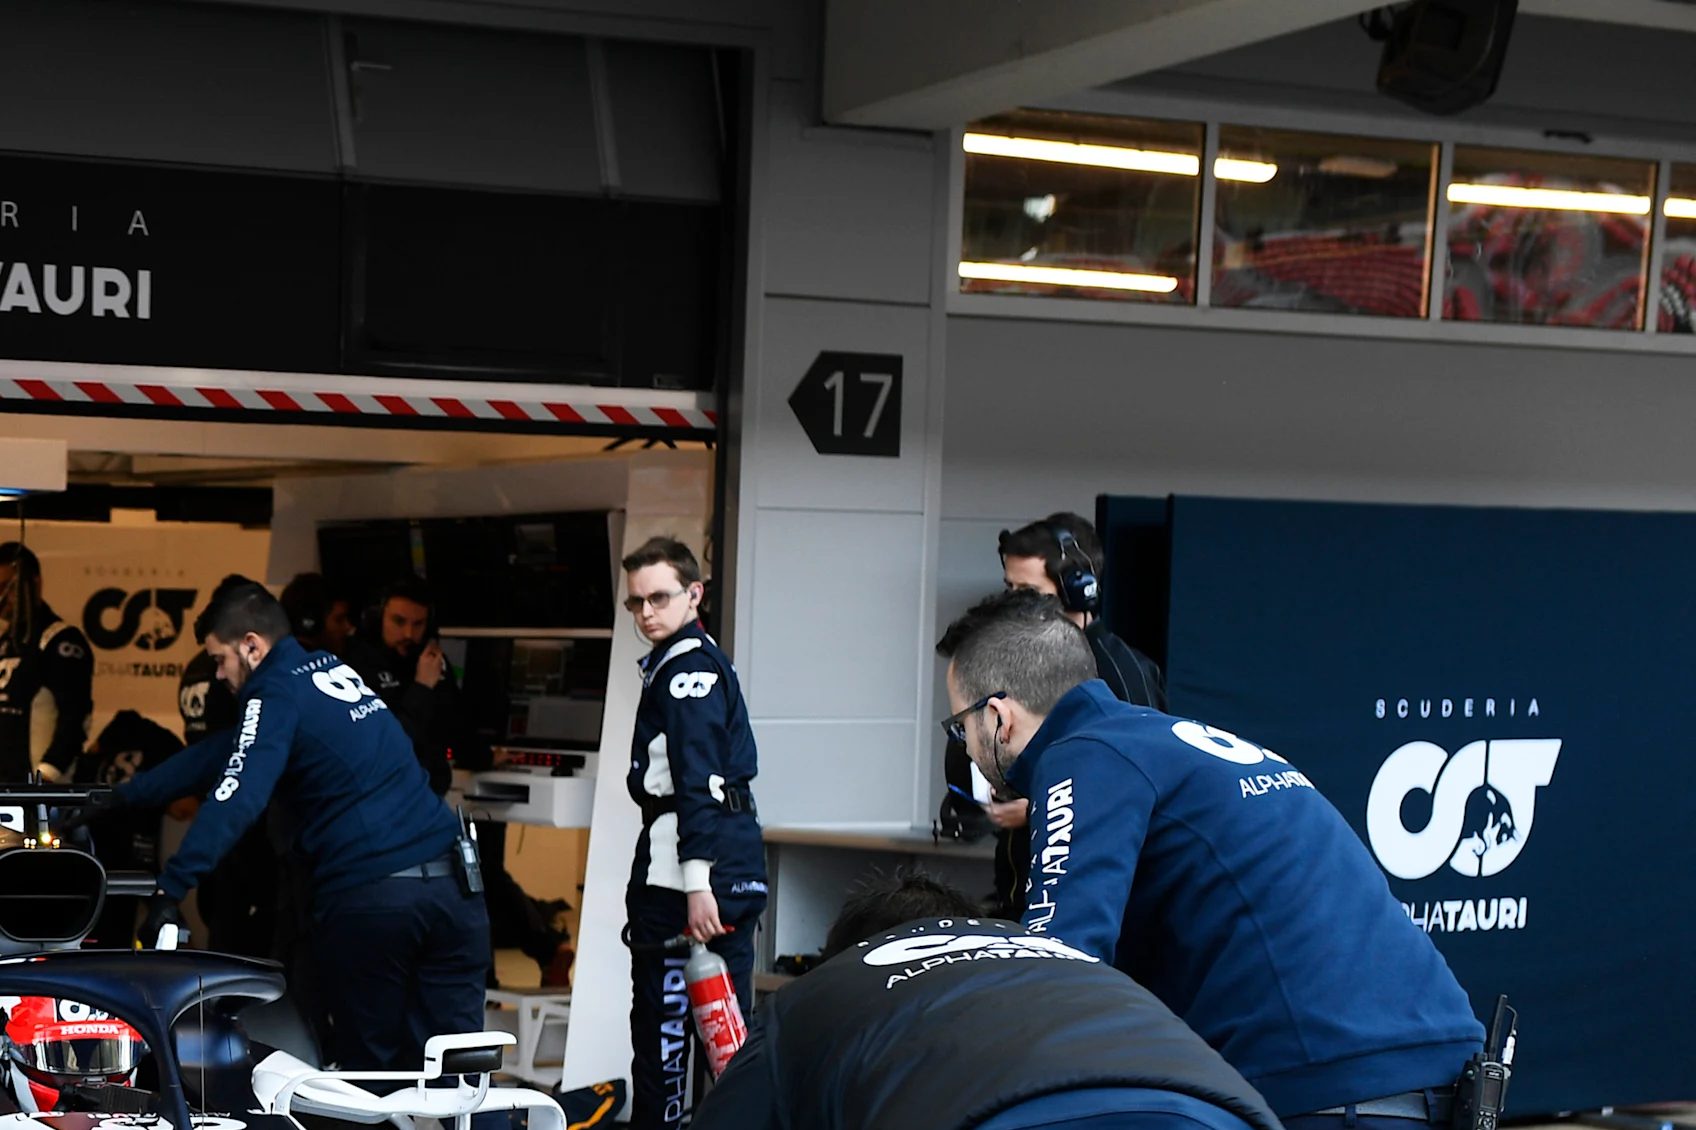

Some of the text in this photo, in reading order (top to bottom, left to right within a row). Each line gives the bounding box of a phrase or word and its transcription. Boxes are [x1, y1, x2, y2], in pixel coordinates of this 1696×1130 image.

[823, 370, 893, 438] 17
[1375, 698, 1540, 719] SCUDERIA
[60, 1024, 120, 1035] HONDA
